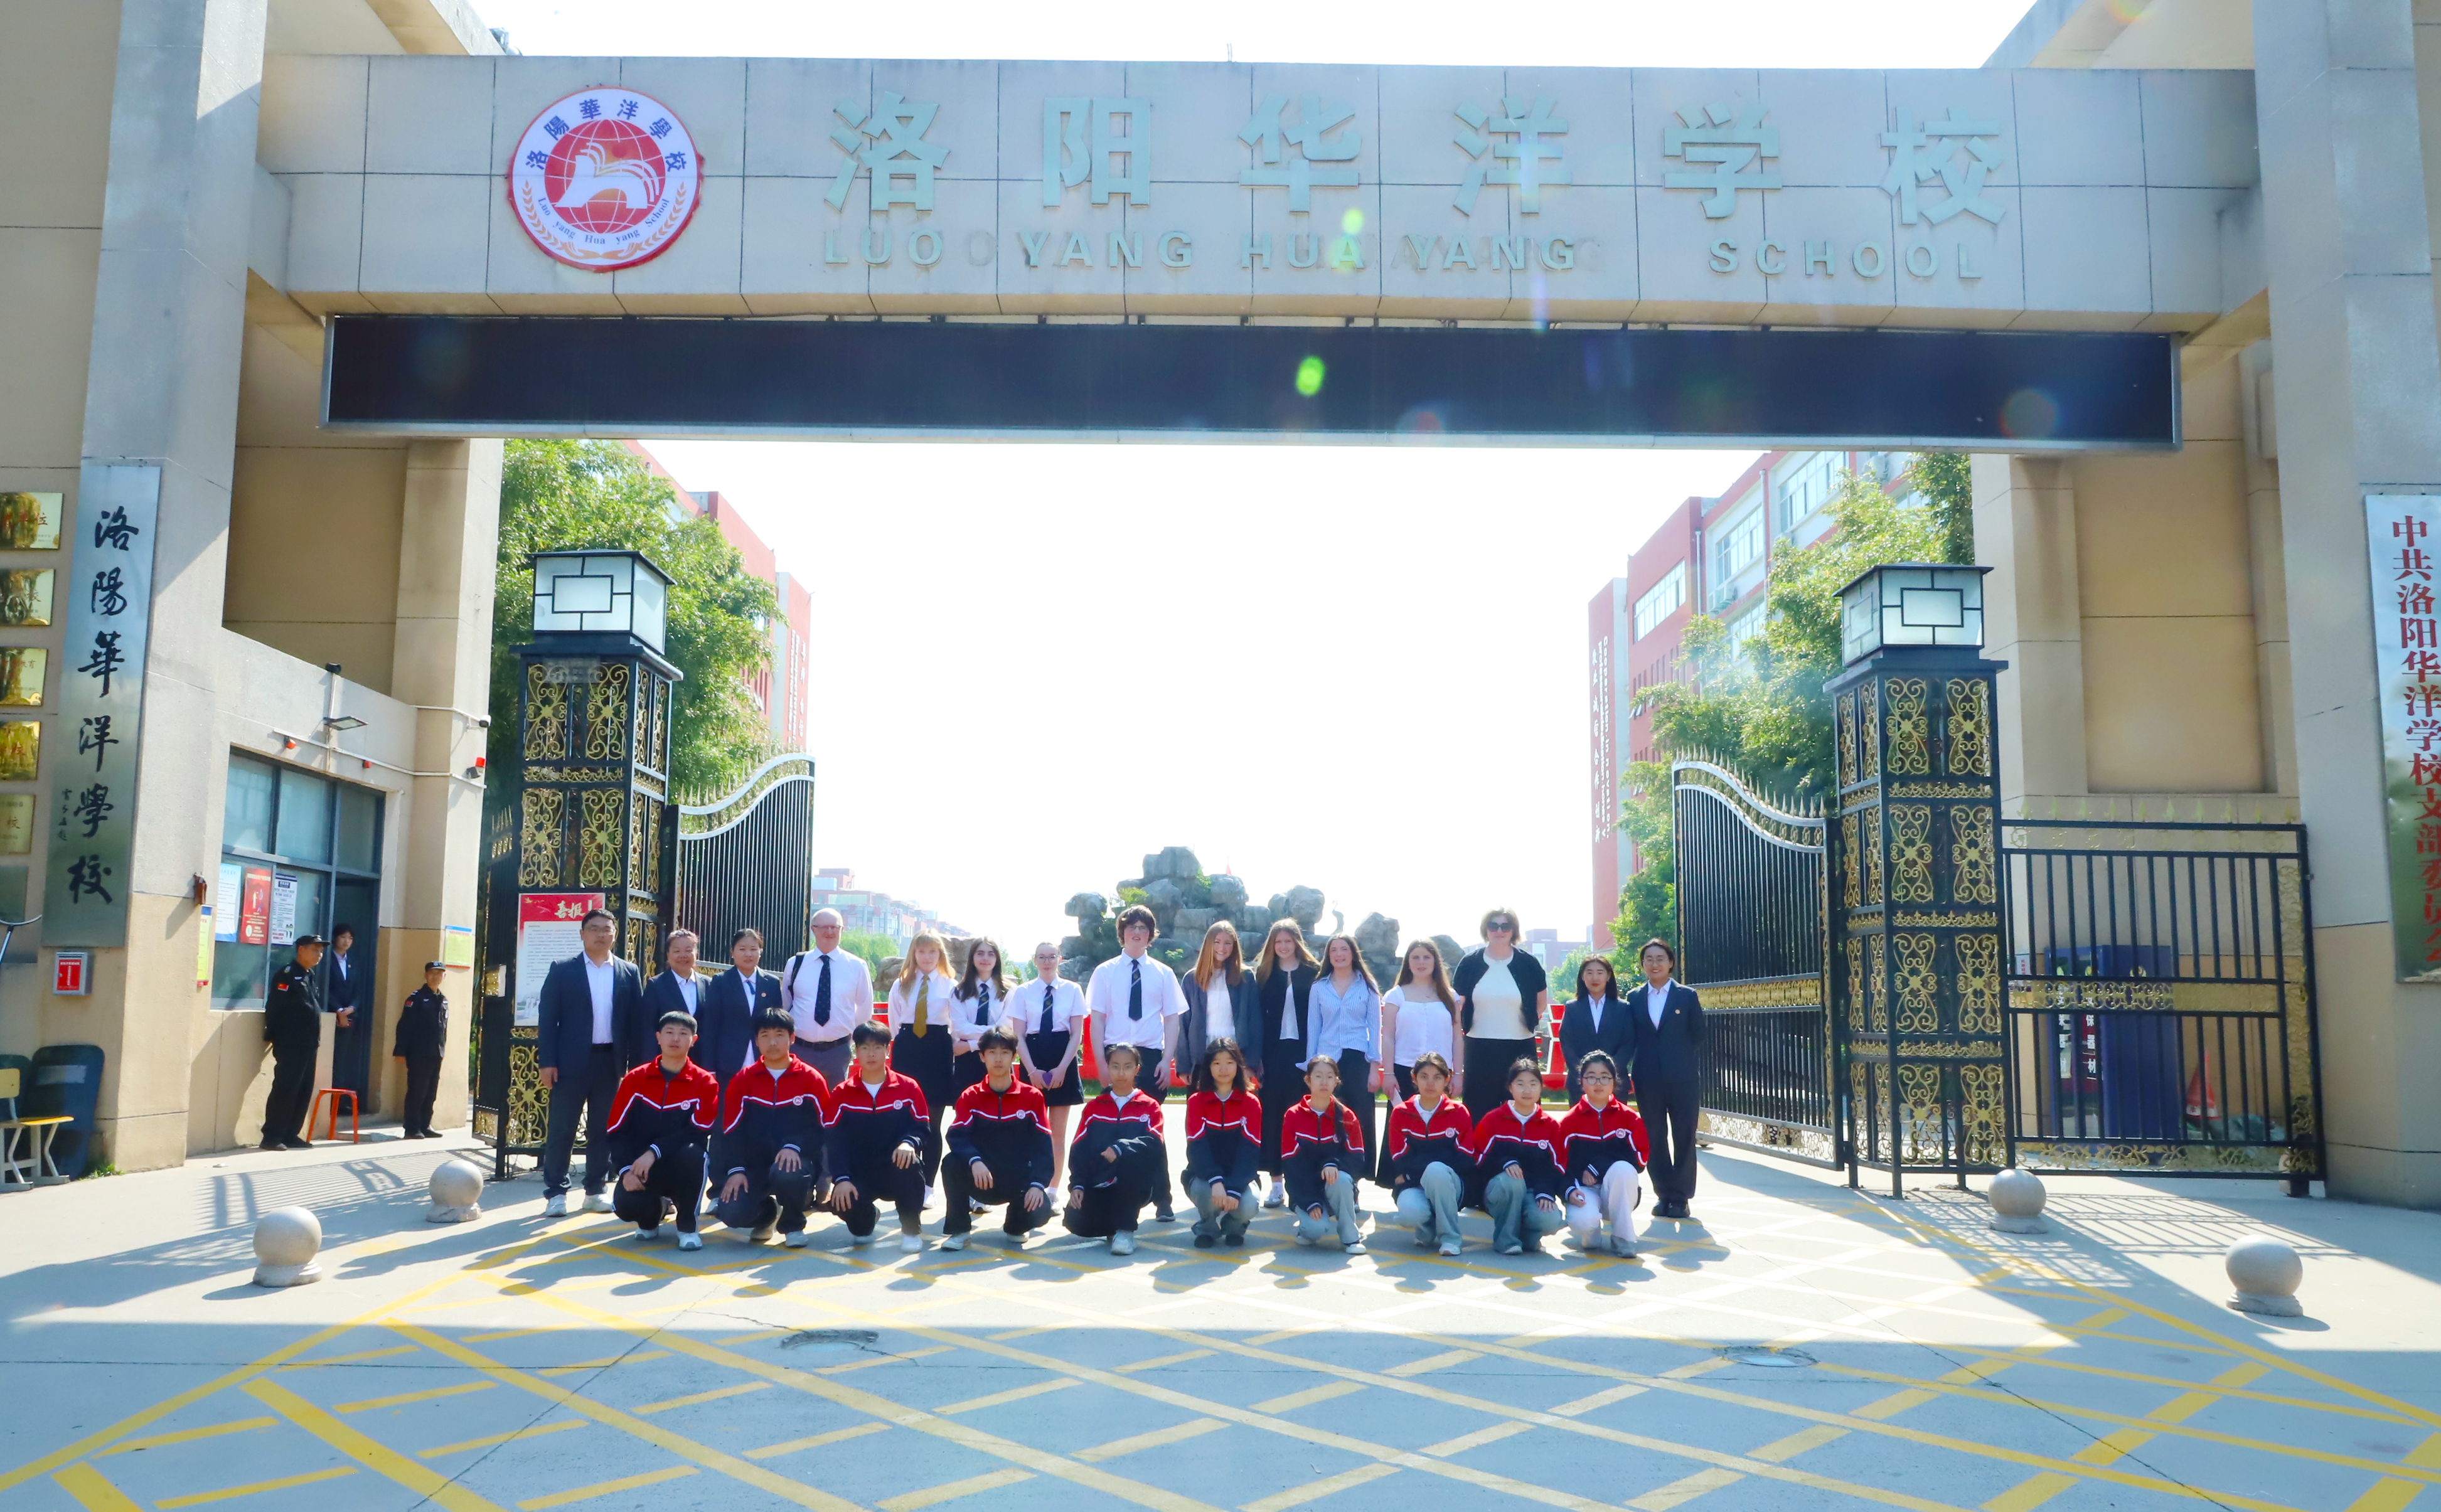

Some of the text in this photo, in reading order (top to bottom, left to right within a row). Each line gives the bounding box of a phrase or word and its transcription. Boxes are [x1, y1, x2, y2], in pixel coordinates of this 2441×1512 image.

[824, 91, 2007, 225] 洛阳华洋学校
[538, 197, 670, 245] Luo yang Hua yang School
[825, 230, 1983, 279] LUO YANG HUA YANG SCHOOL
